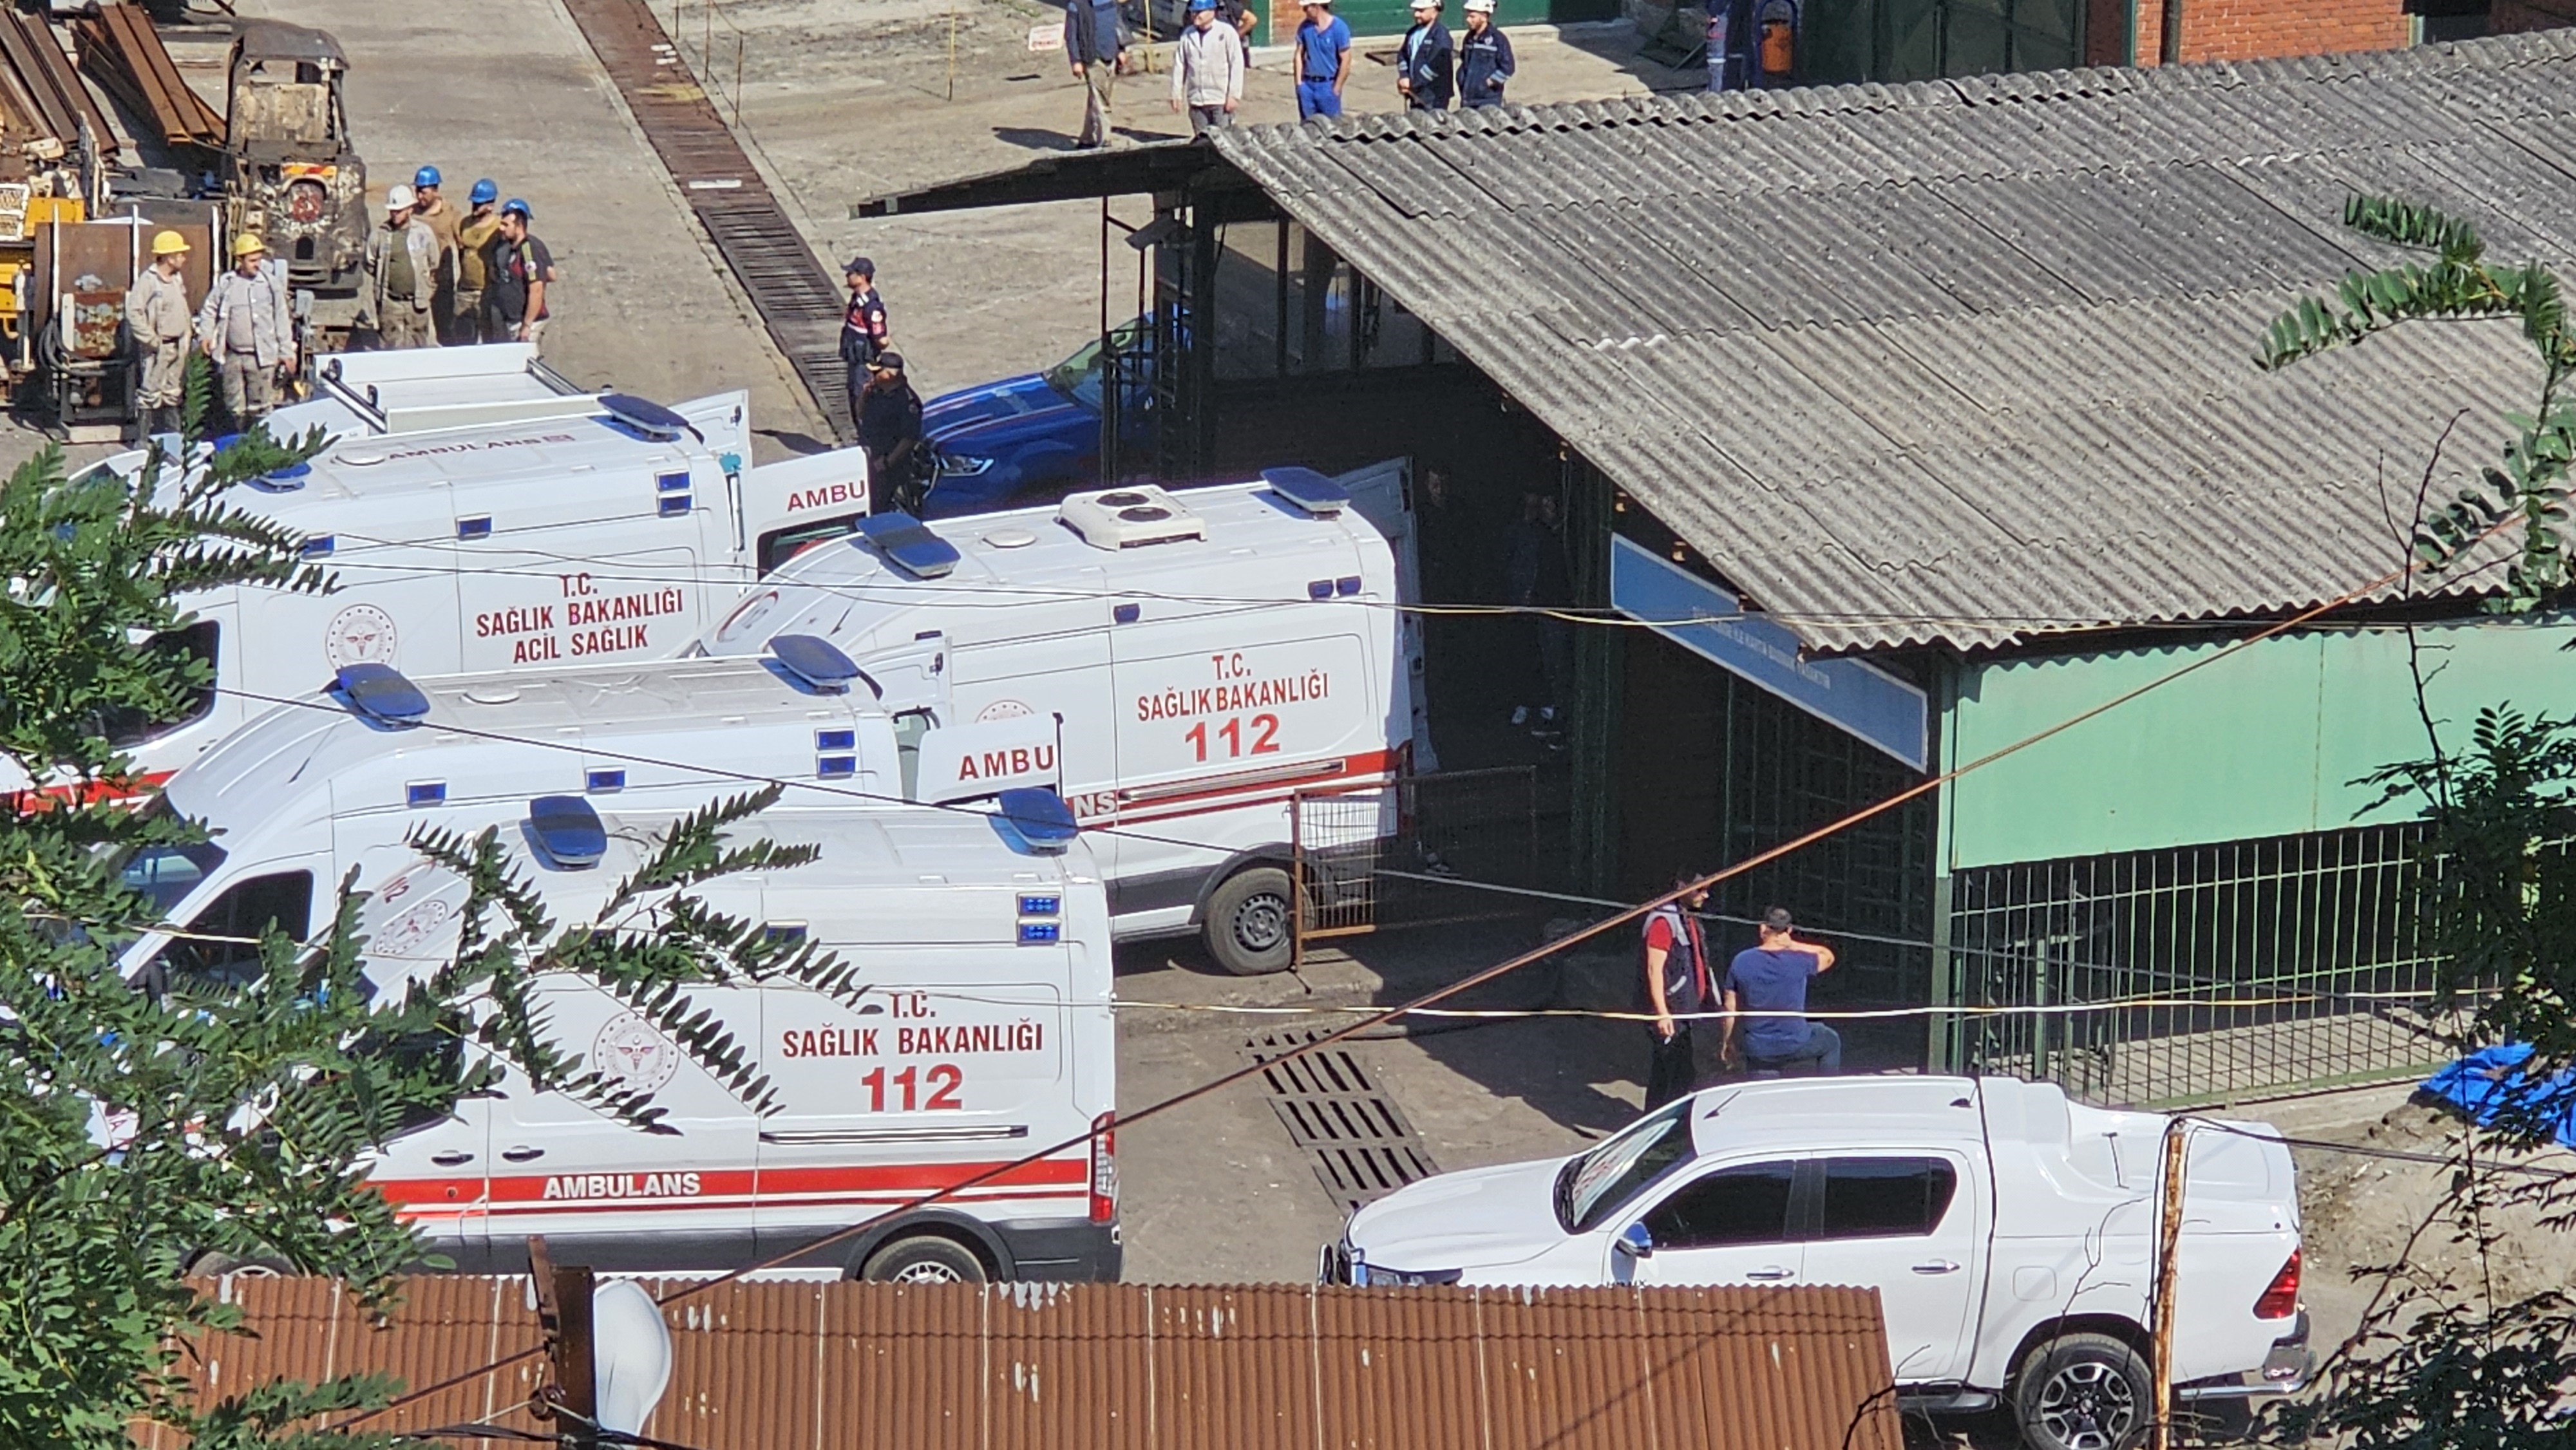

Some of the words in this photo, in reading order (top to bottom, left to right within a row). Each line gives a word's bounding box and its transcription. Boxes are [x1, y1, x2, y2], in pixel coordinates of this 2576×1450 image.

[390, 438, 541, 459] AMBULANS
[788, 480, 865, 511] AMBU
[558, 572, 598, 598] T.C.
[477, 605, 554, 637] SAĞLIK
[568, 586, 683, 625] BAKANLIĞI
[513, 633, 561, 663] ACİL
[571, 625, 648, 655] SAĞLIK
[1212, 652, 1251, 680] T.C.
[1138, 686, 1211, 721] SAĞLIK
[1216, 668, 1328, 711] BAKANLIĞI
[1185, 713, 1280, 762] 112
[959, 745, 1054, 780] AMBU
[889, 990, 936, 1017] T.C.
[782, 1022, 879, 1057] SAĞLIK
[898, 1017, 1043, 1055] BAKANLIĞI
[862, 1063, 963, 1112] 112
[544, 1172, 701, 1199] AMBULANS
